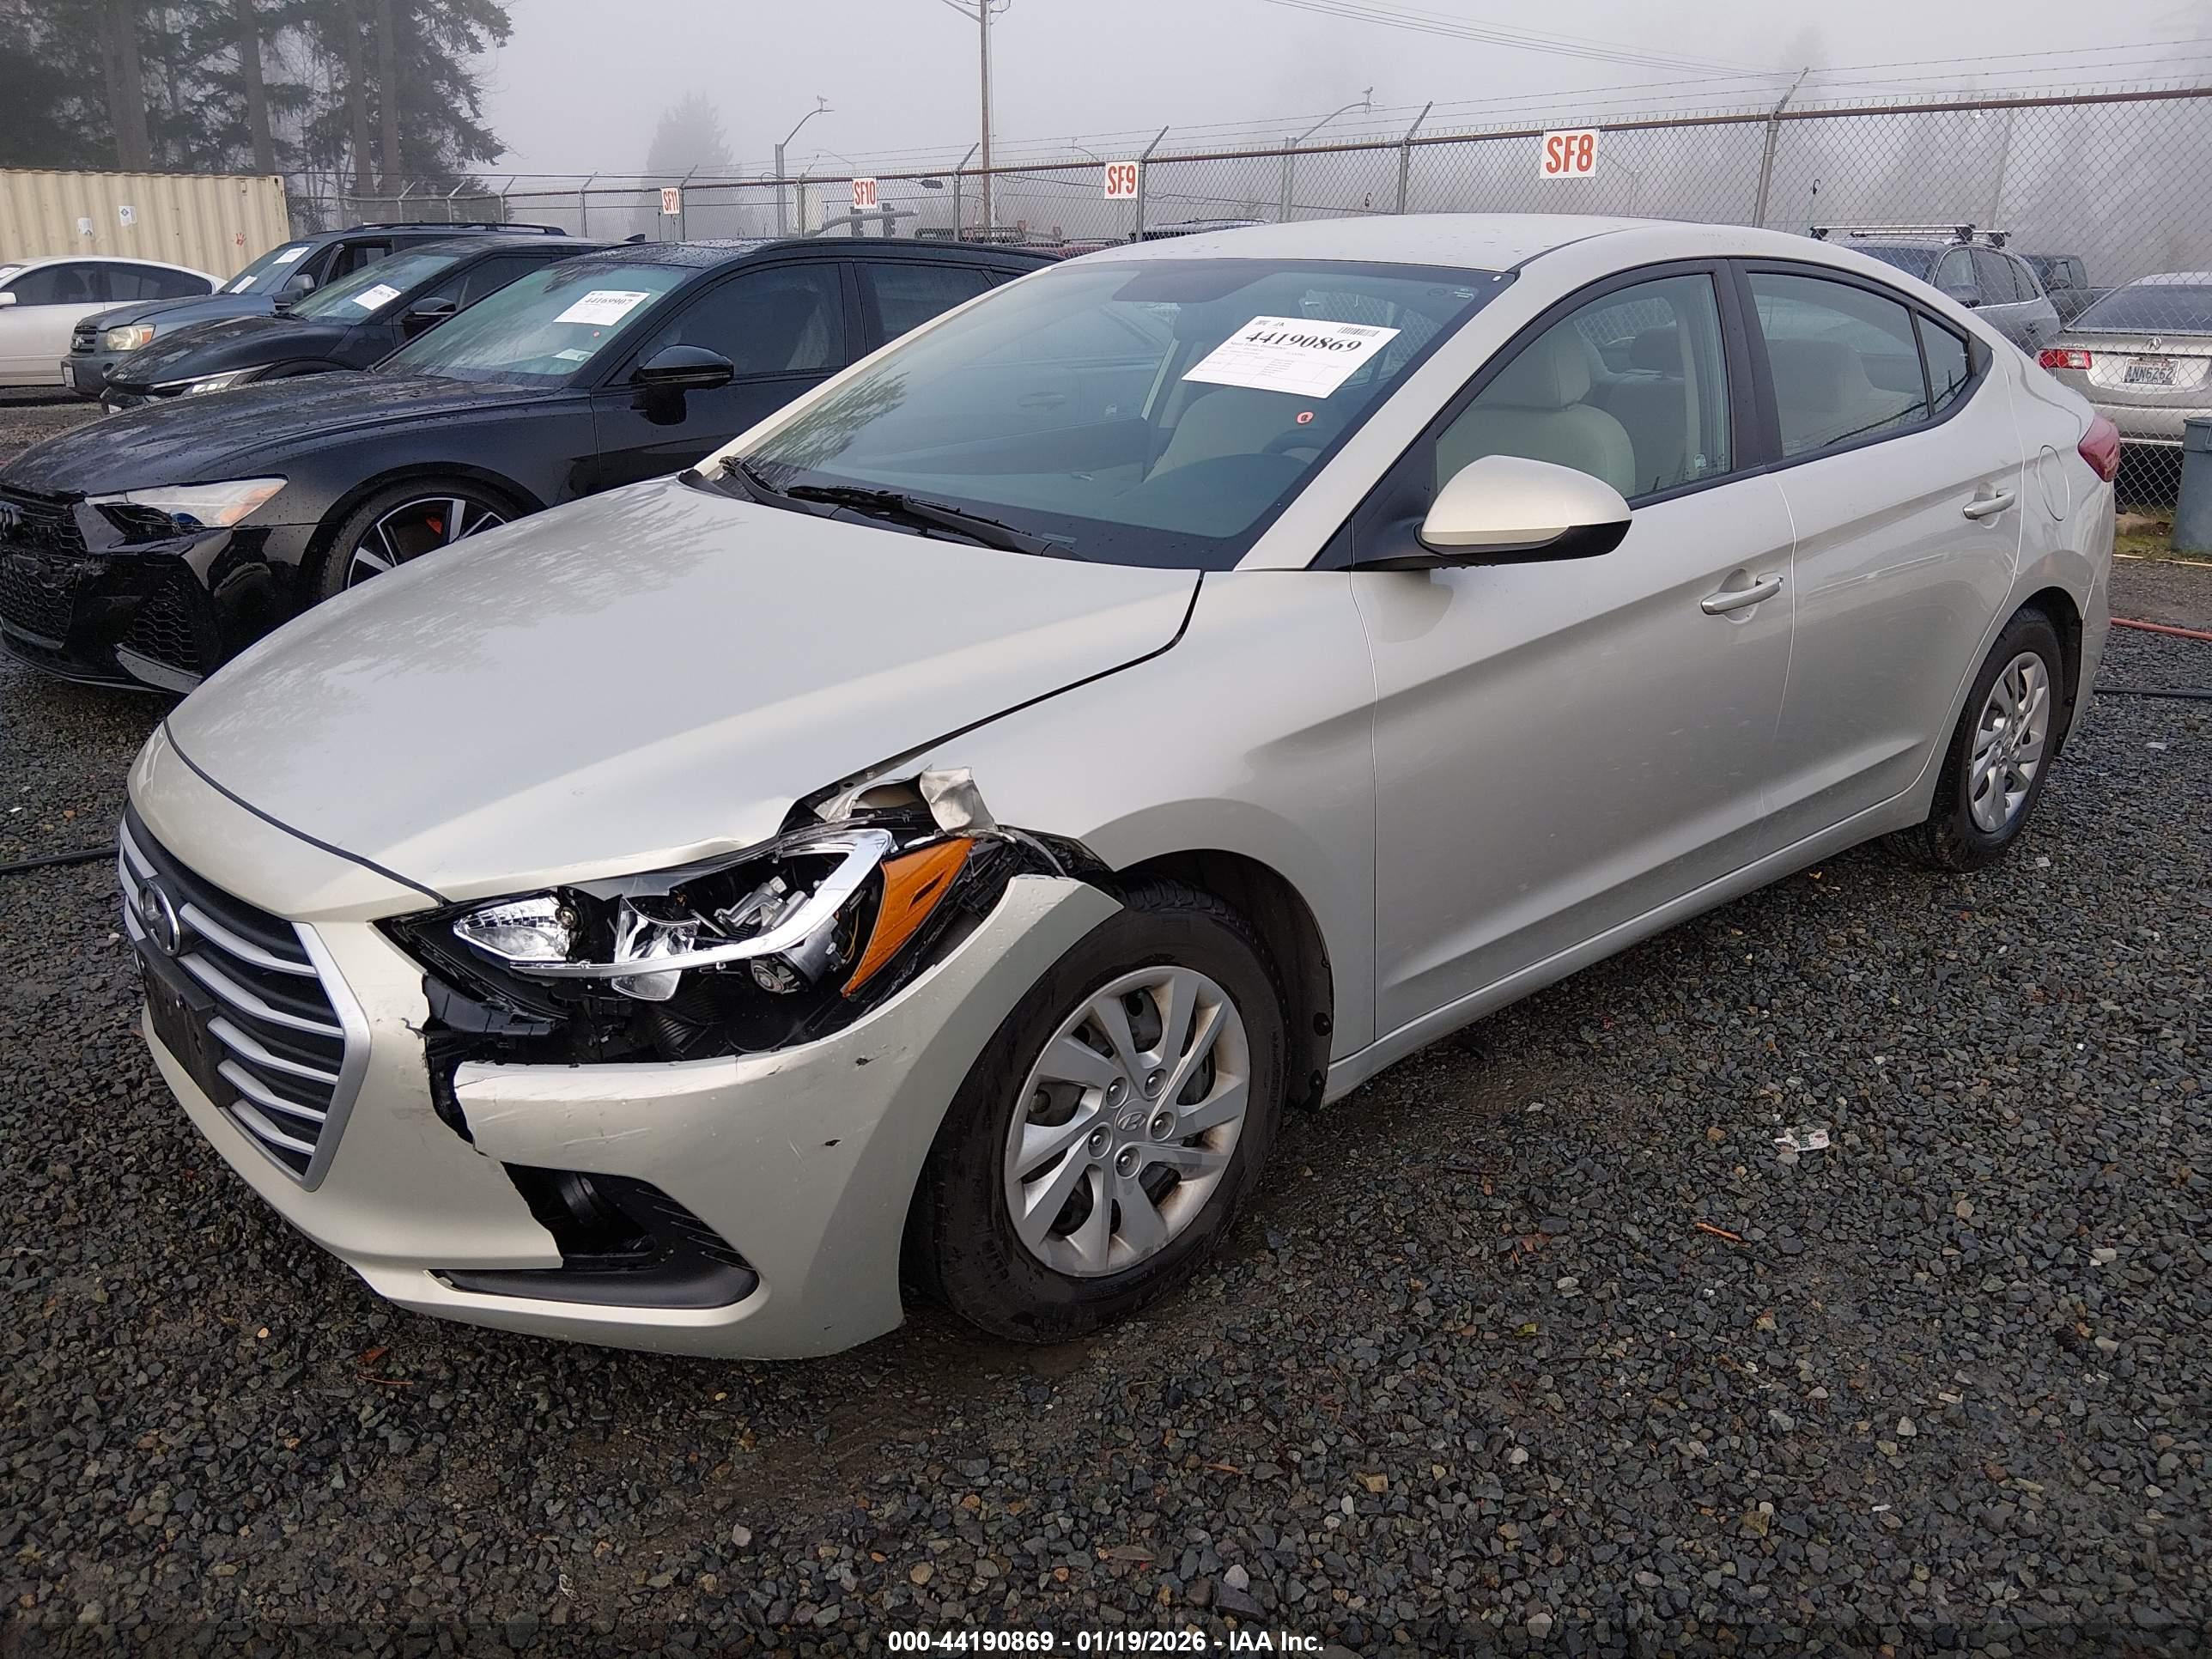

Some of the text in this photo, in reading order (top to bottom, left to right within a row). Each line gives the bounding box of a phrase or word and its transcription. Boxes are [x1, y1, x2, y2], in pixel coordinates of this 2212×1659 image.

[1546, 133, 1594, 173] SF8
[854, 179, 876, 206] SF10
[1107, 165, 1136, 195] SF9
[663, 191, 679, 212] SF11
[1245, 331, 1363, 353] 44190869
